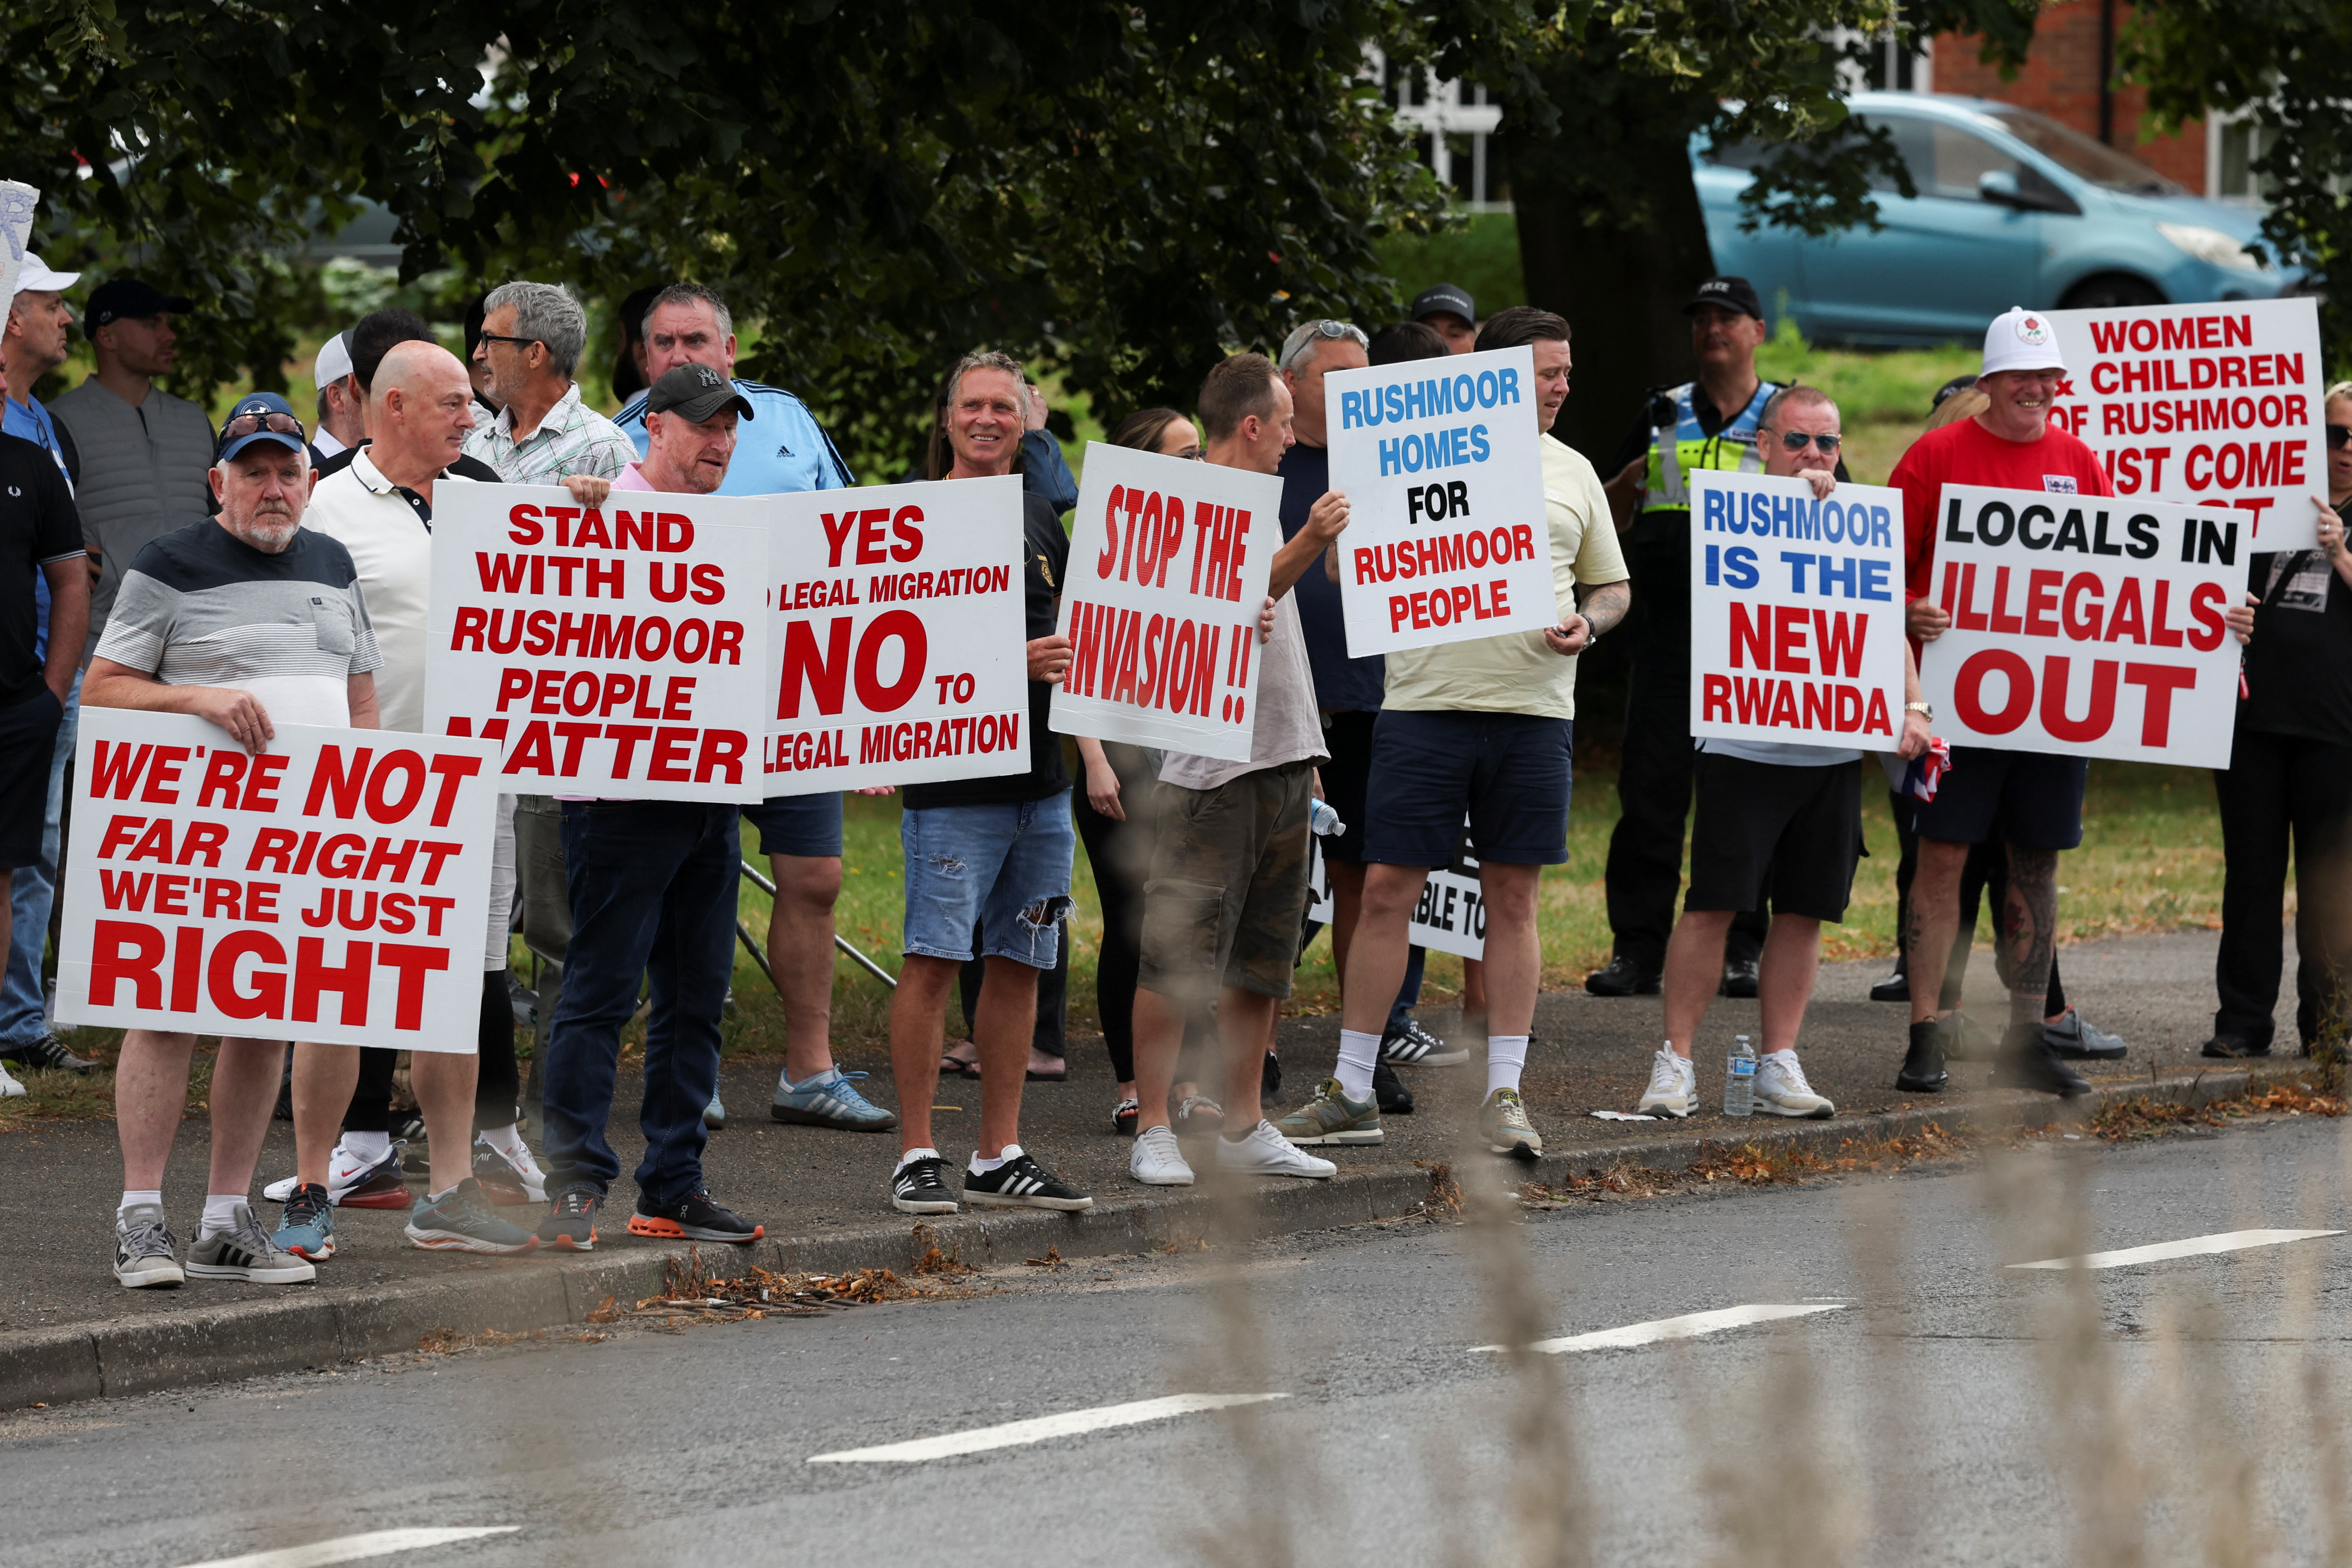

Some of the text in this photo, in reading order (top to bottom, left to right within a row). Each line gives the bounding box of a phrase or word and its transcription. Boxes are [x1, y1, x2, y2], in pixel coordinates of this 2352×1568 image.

[2090, 315, 2252, 353] WOMEN
[1341, 368, 1520, 429] RUSHMOOR
[2091, 353, 2304, 395] CHILDREN
[2048, 394, 2308, 437] OF RUSHMOOR
[1379, 424, 1490, 476] HOMES
[2092, 440, 2307, 495] ST COME
[508, 504, 694, 552] STAND
[1407, 481, 1470, 524] FOR
[1704, 489, 1891, 547] RUSHMOOR
[820, 505, 924, 567] YES
[1097, 484, 1251, 602] STOP THE
[1354, 524, 1535, 585] RUSHMOOR
[1946, 499, 2159, 559] LOCALS
[2181, 519, 2237, 566] IN
[476, 552, 624, 599] WITH
[650, 561, 725, 605] US
[780, 578, 859, 611] LEGAL
[869, 565, 1010, 603] MIGRATION
[1706, 544, 1891, 602] IS THE
[1389, 579, 1510, 633] PEOPLE
[1941, 561, 2226, 652] ILLEGALS
[451, 607, 744, 665] RUSHMOOR
[777, 610, 975, 720] NO TO
[1063, 600, 1253, 724] INVASION !!
[1730, 602, 1868, 678] NEW
[496, 668, 697, 721] PEOPLE
[1703, 673, 1892, 736] RWANDA
[1954, 649, 2196, 747] OUT
[860, 713, 1019, 764] MIGRATION
[90, 740, 482, 827] WE'RE NOT
[97, 815, 463, 886] FAR RIGHT
[99, 869, 455, 936] WE'RE JUST
[1411, 881, 1486, 940] BLE TO
[88, 919, 450, 1031] RIGHT
